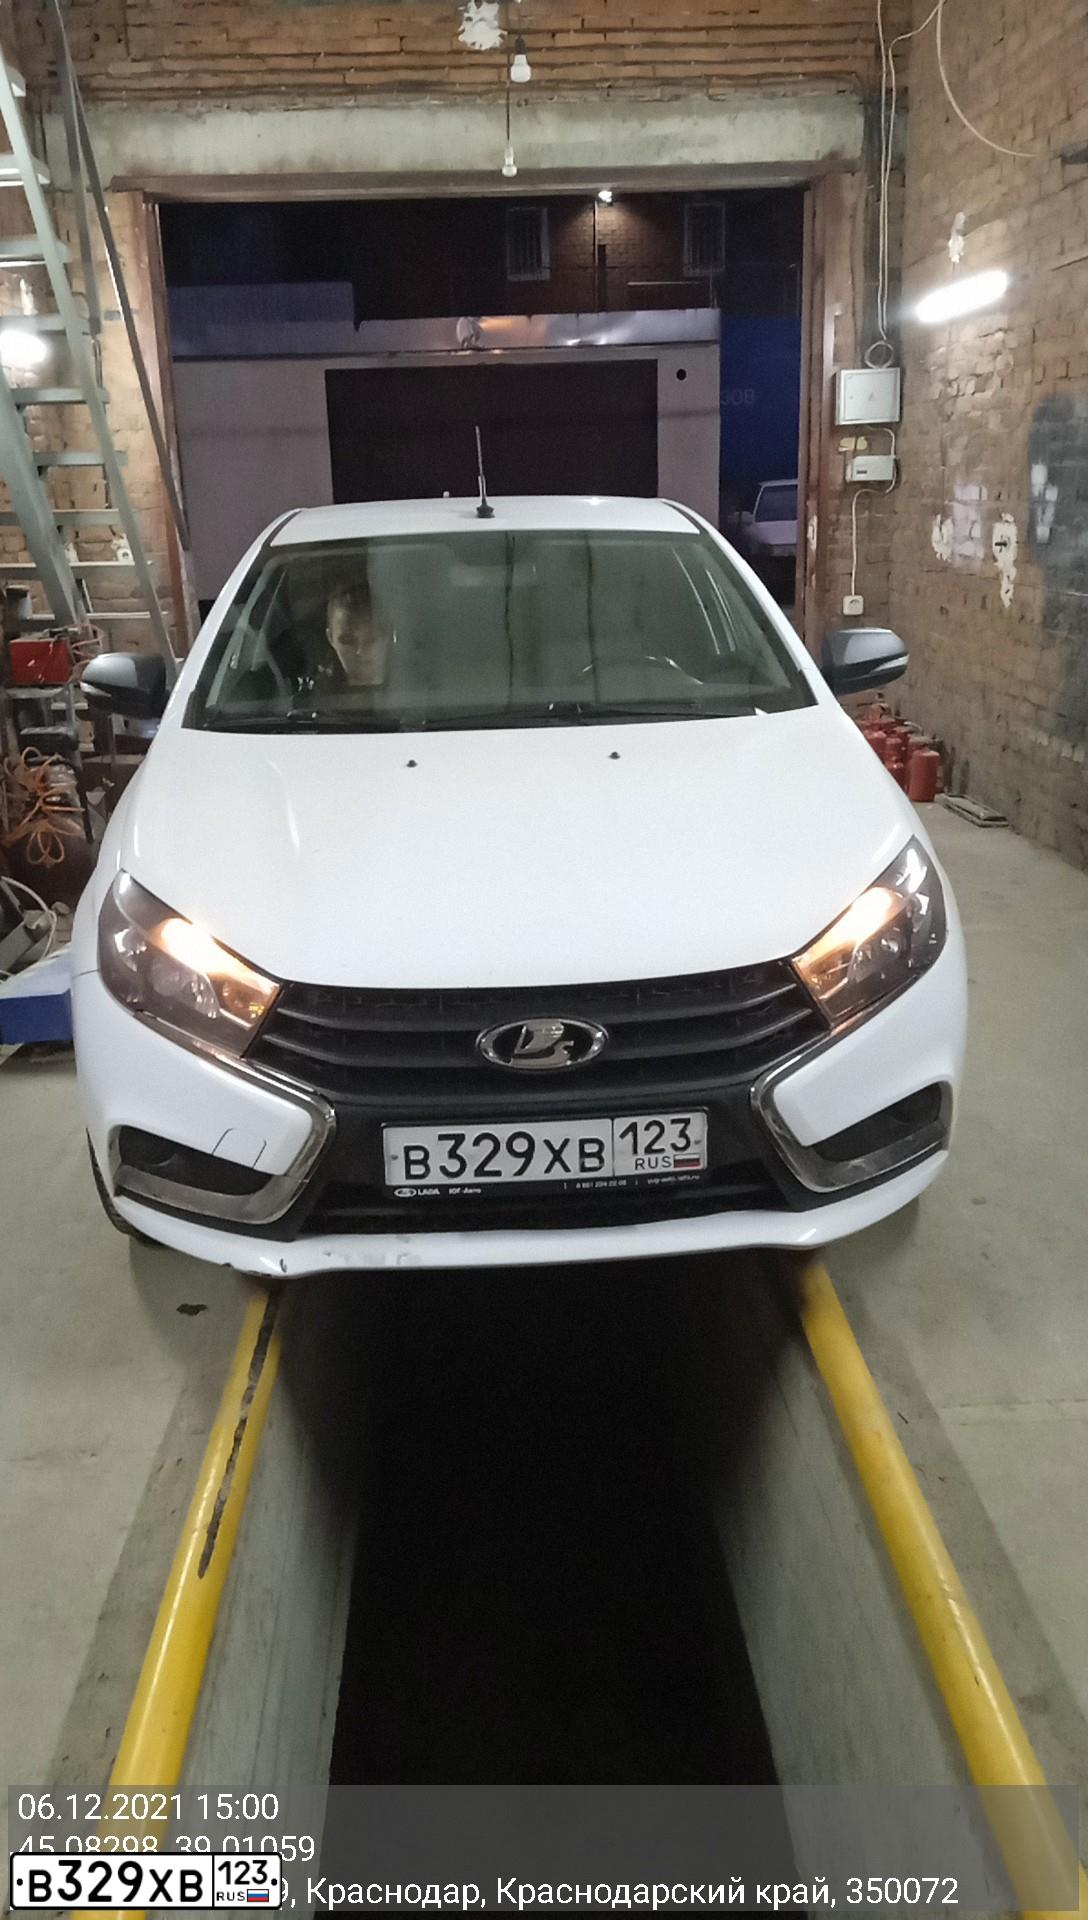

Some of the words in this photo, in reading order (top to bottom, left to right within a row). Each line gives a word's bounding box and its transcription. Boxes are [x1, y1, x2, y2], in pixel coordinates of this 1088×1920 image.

[403, 1130, 606, 1181] В329ХВ
[618, 1117, 692, 1155] 123
[634, 1155, 672, 1171] RUS
